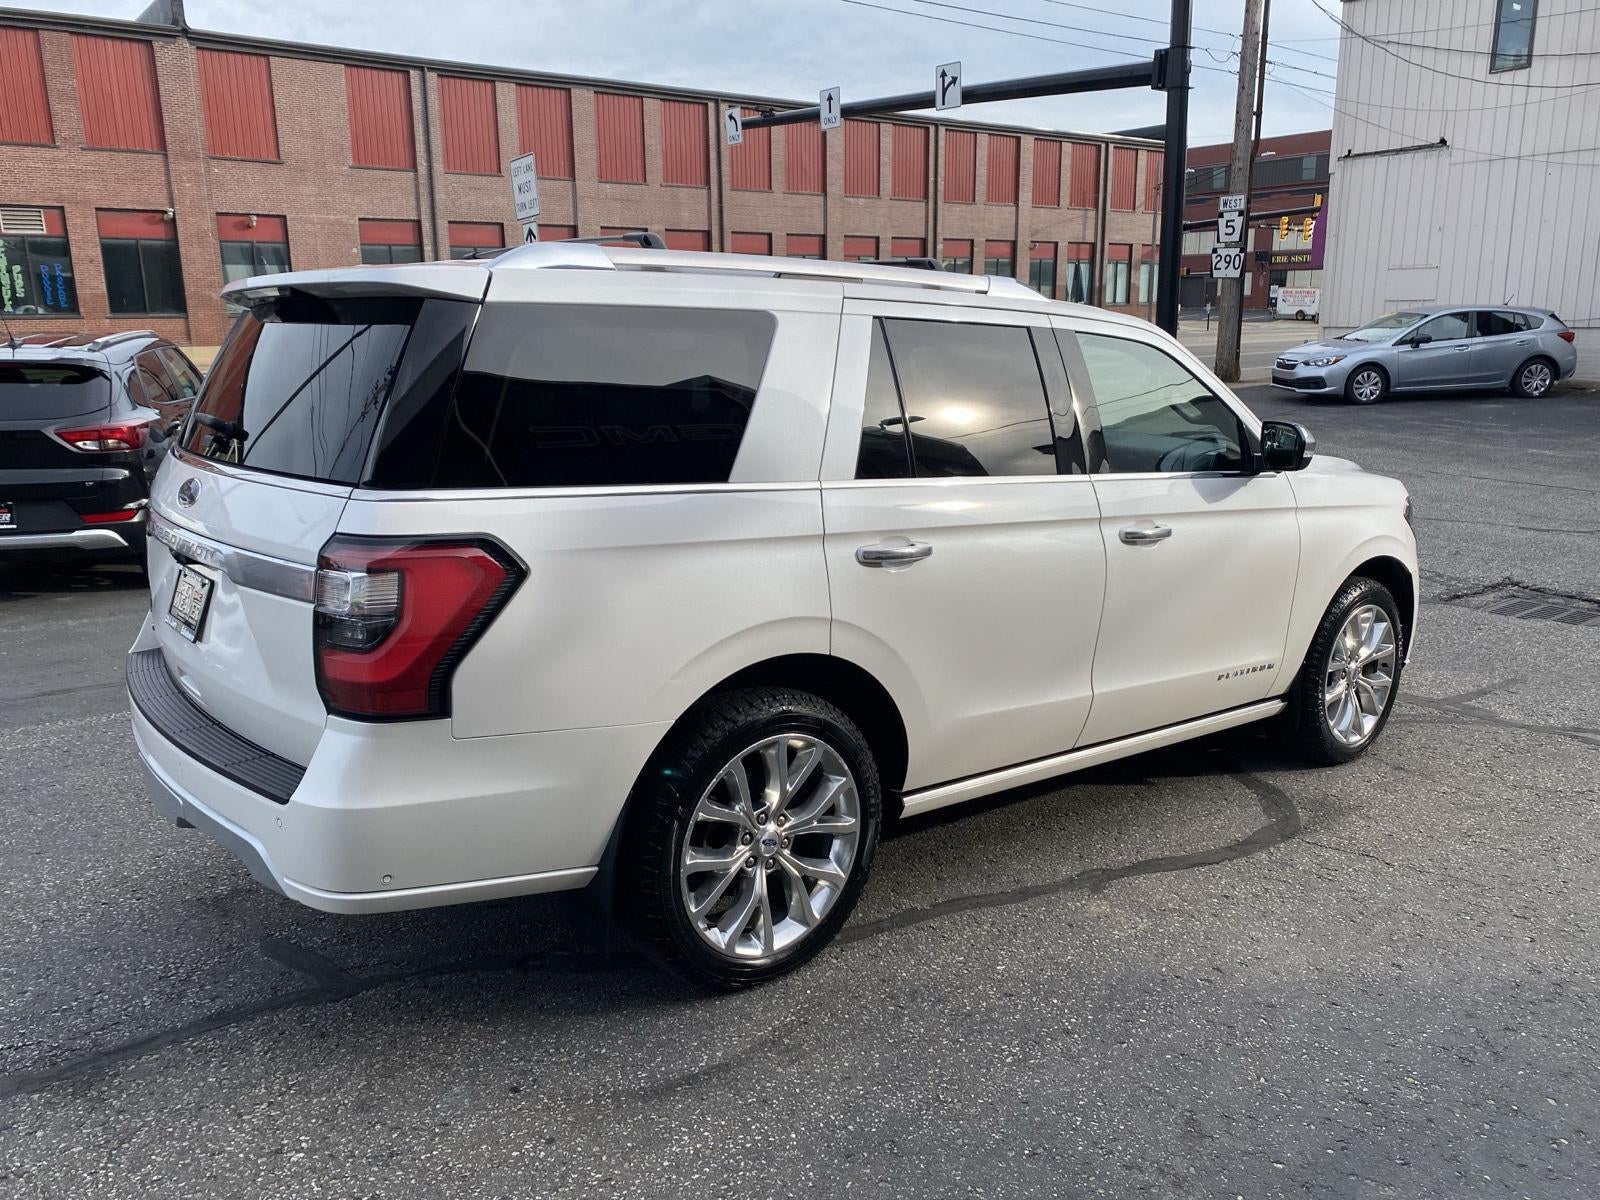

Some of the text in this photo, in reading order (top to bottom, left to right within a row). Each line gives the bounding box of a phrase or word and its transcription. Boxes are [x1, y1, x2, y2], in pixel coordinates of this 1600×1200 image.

[823, 115, 838, 126] ONLY
[729, 134, 740, 142] ONLY
[512, 161, 533, 178] LEFT LANE
[517, 180, 531, 195] MUST
[516, 198, 538, 212] TURN LEFT
[1222, 198, 1242, 209] WEST
[1224, 219, 1236, 236] 5
[1213, 253, 1242, 271] 290
[1271, 255, 1289, 263] ERIE
